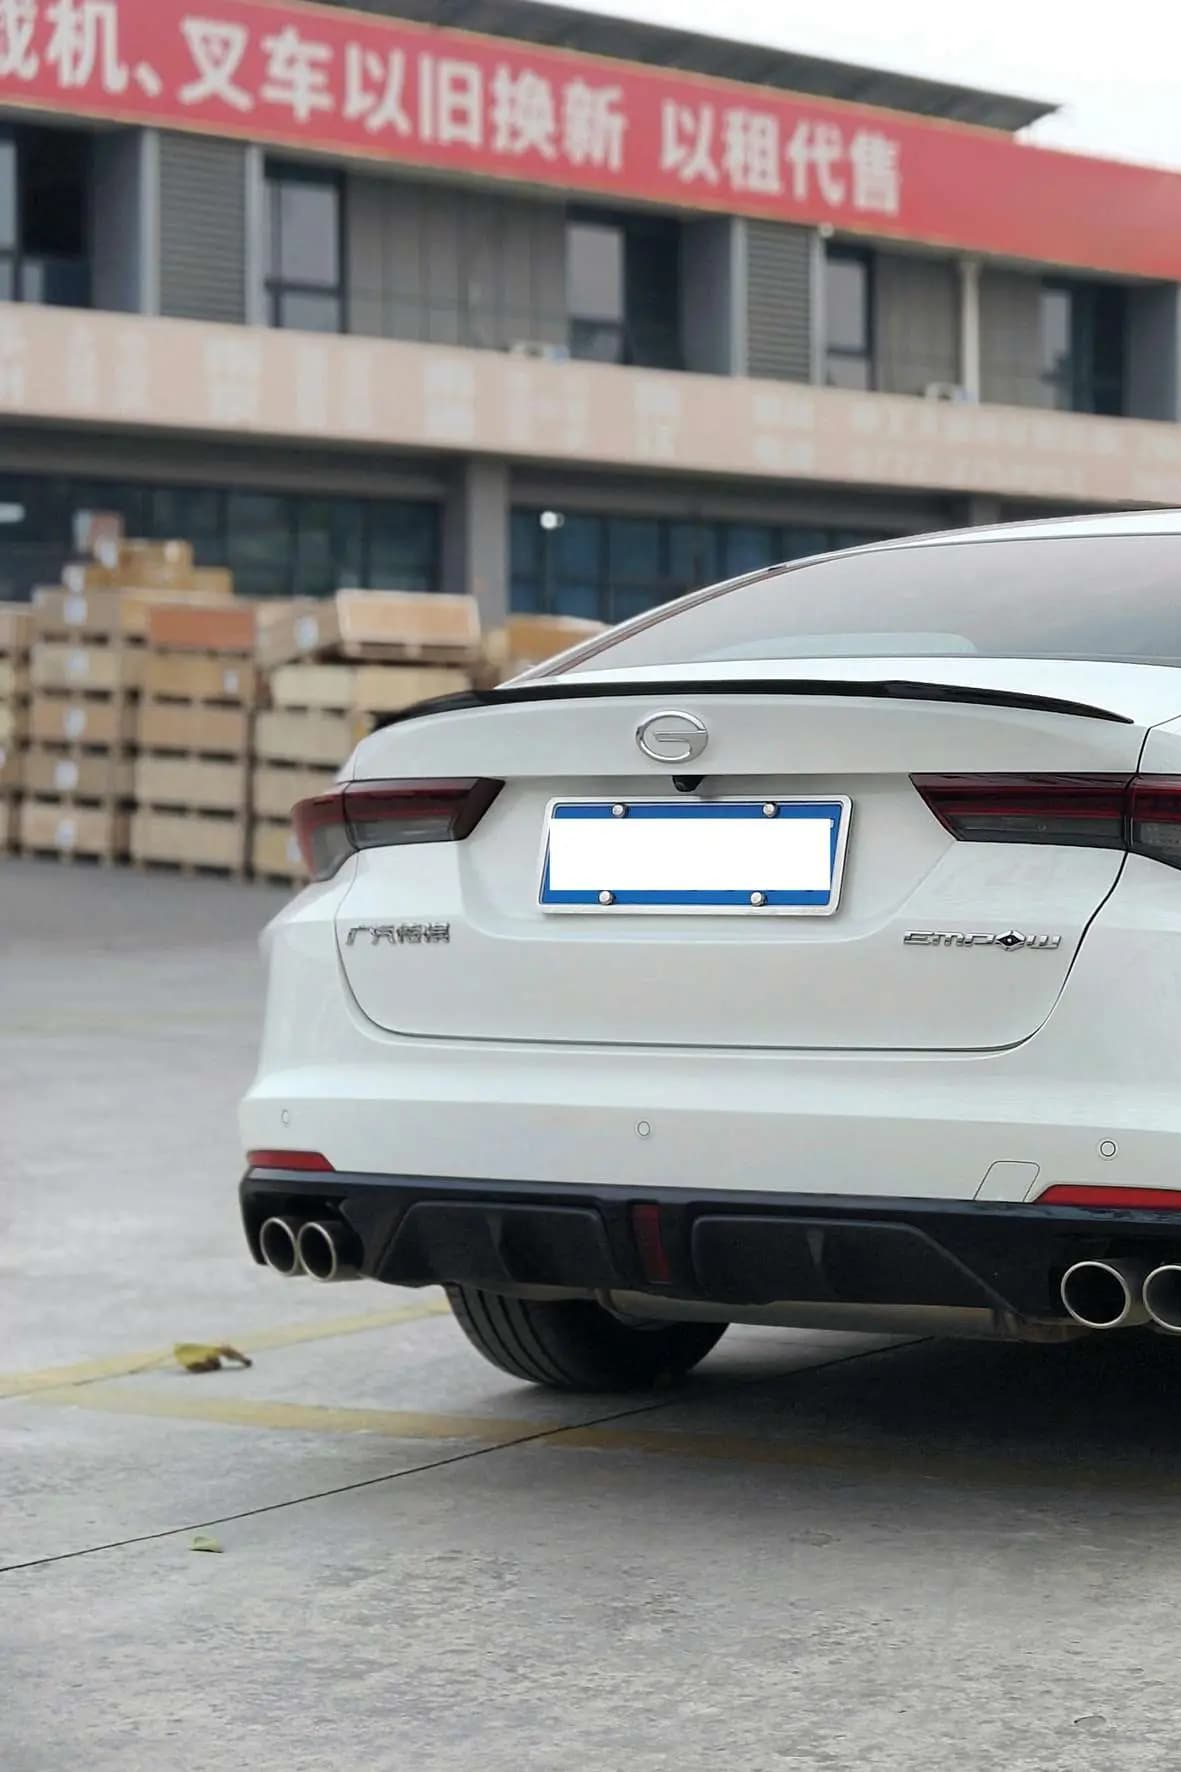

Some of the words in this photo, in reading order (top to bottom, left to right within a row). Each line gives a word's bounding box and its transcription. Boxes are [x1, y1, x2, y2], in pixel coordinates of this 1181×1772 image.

[660, 98, 900, 216] 以租代售
[345, 922, 450, 946] 广汽传祺
